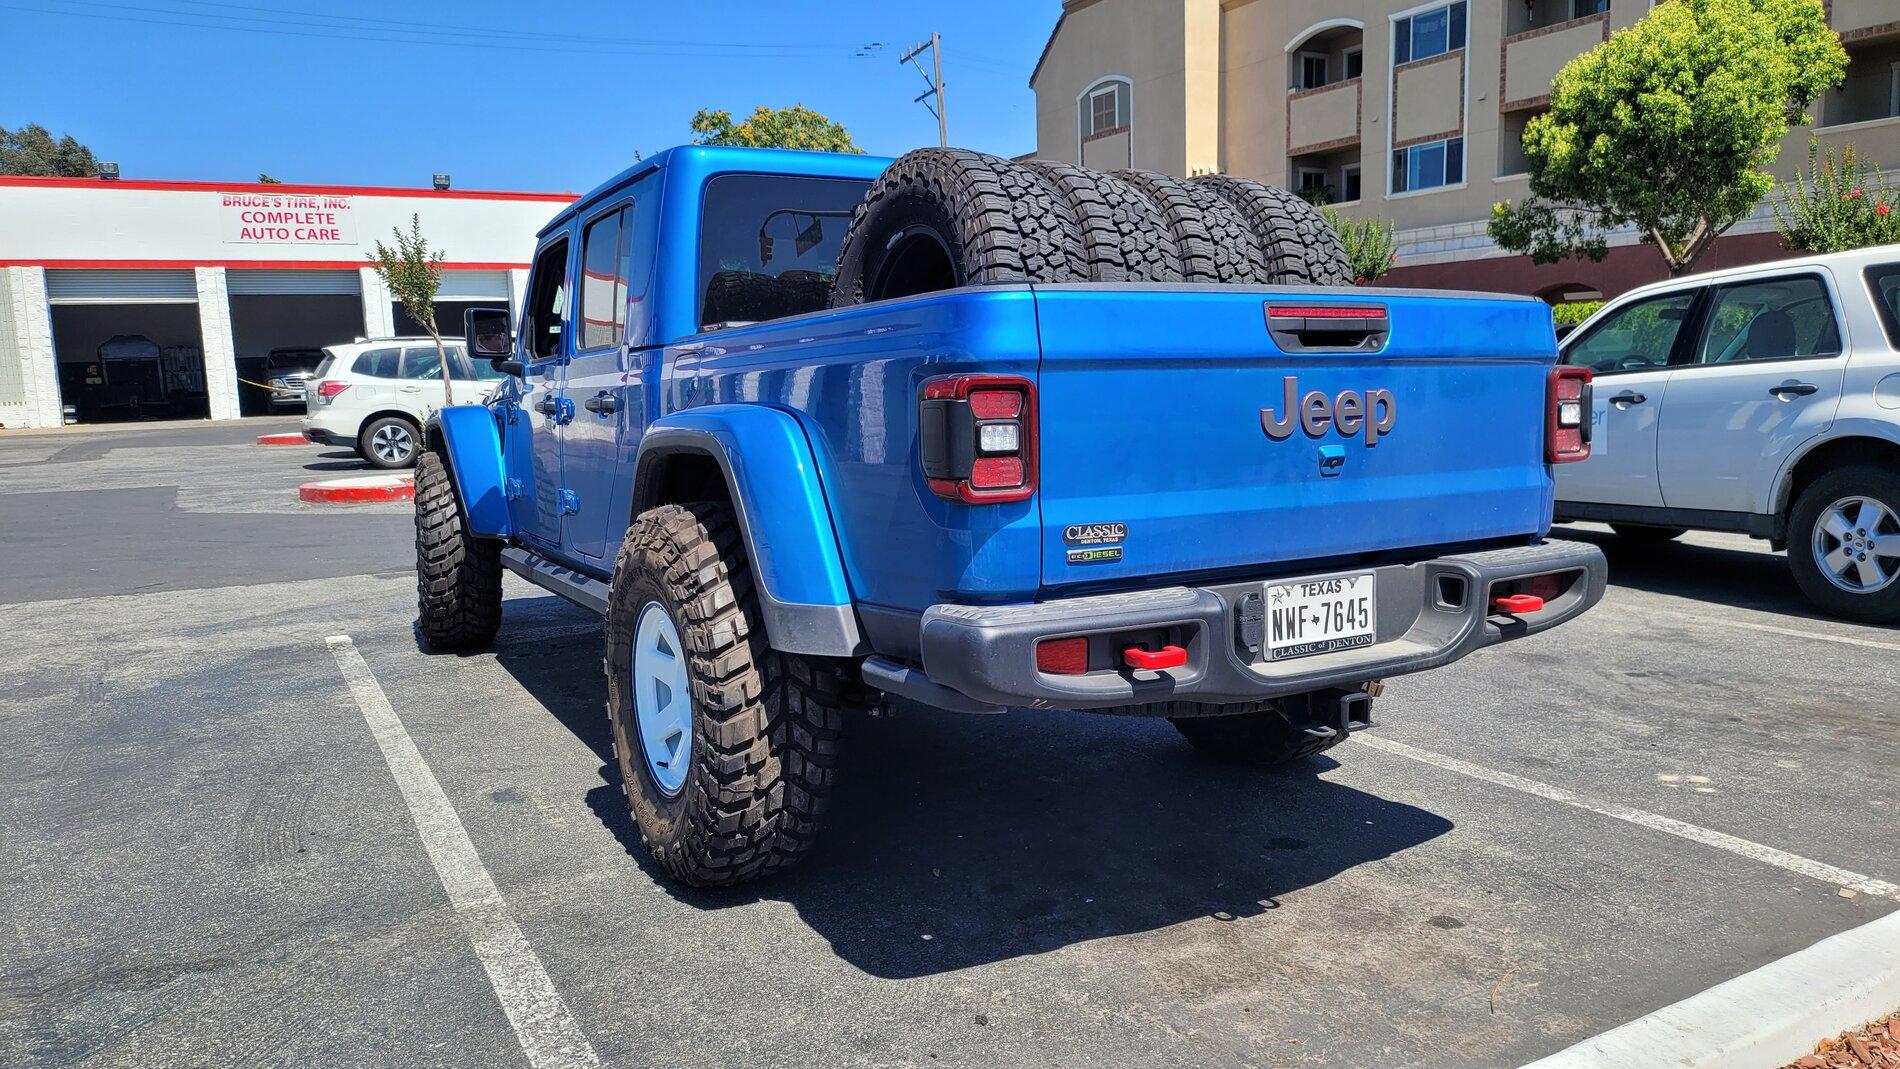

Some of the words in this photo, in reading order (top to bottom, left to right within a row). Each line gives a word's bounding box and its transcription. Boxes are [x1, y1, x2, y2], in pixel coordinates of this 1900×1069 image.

[222, 195, 282, 208] BRUCE'S
[286, 197, 320, 210] TIRE,
[323, 199, 351, 210] INC.
[240, 211, 336, 225] COMPLETE
[240, 227, 290, 240] AUTO
[294, 228, 340, 240] CARE
[1260, 375, 1397, 448] Jeep
[1066, 523, 1125, 540] CLASSIC
[1300, 580, 1342, 597] TEXAS
[1272, 604, 1309, 642] NWF
[1321, 597, 1369, 634] 7645
[1273, 642, 1317, 659] CLASSIC
[1318, 640, 1326, 649] of
[1328, 634, 1373, 651] DENTON
